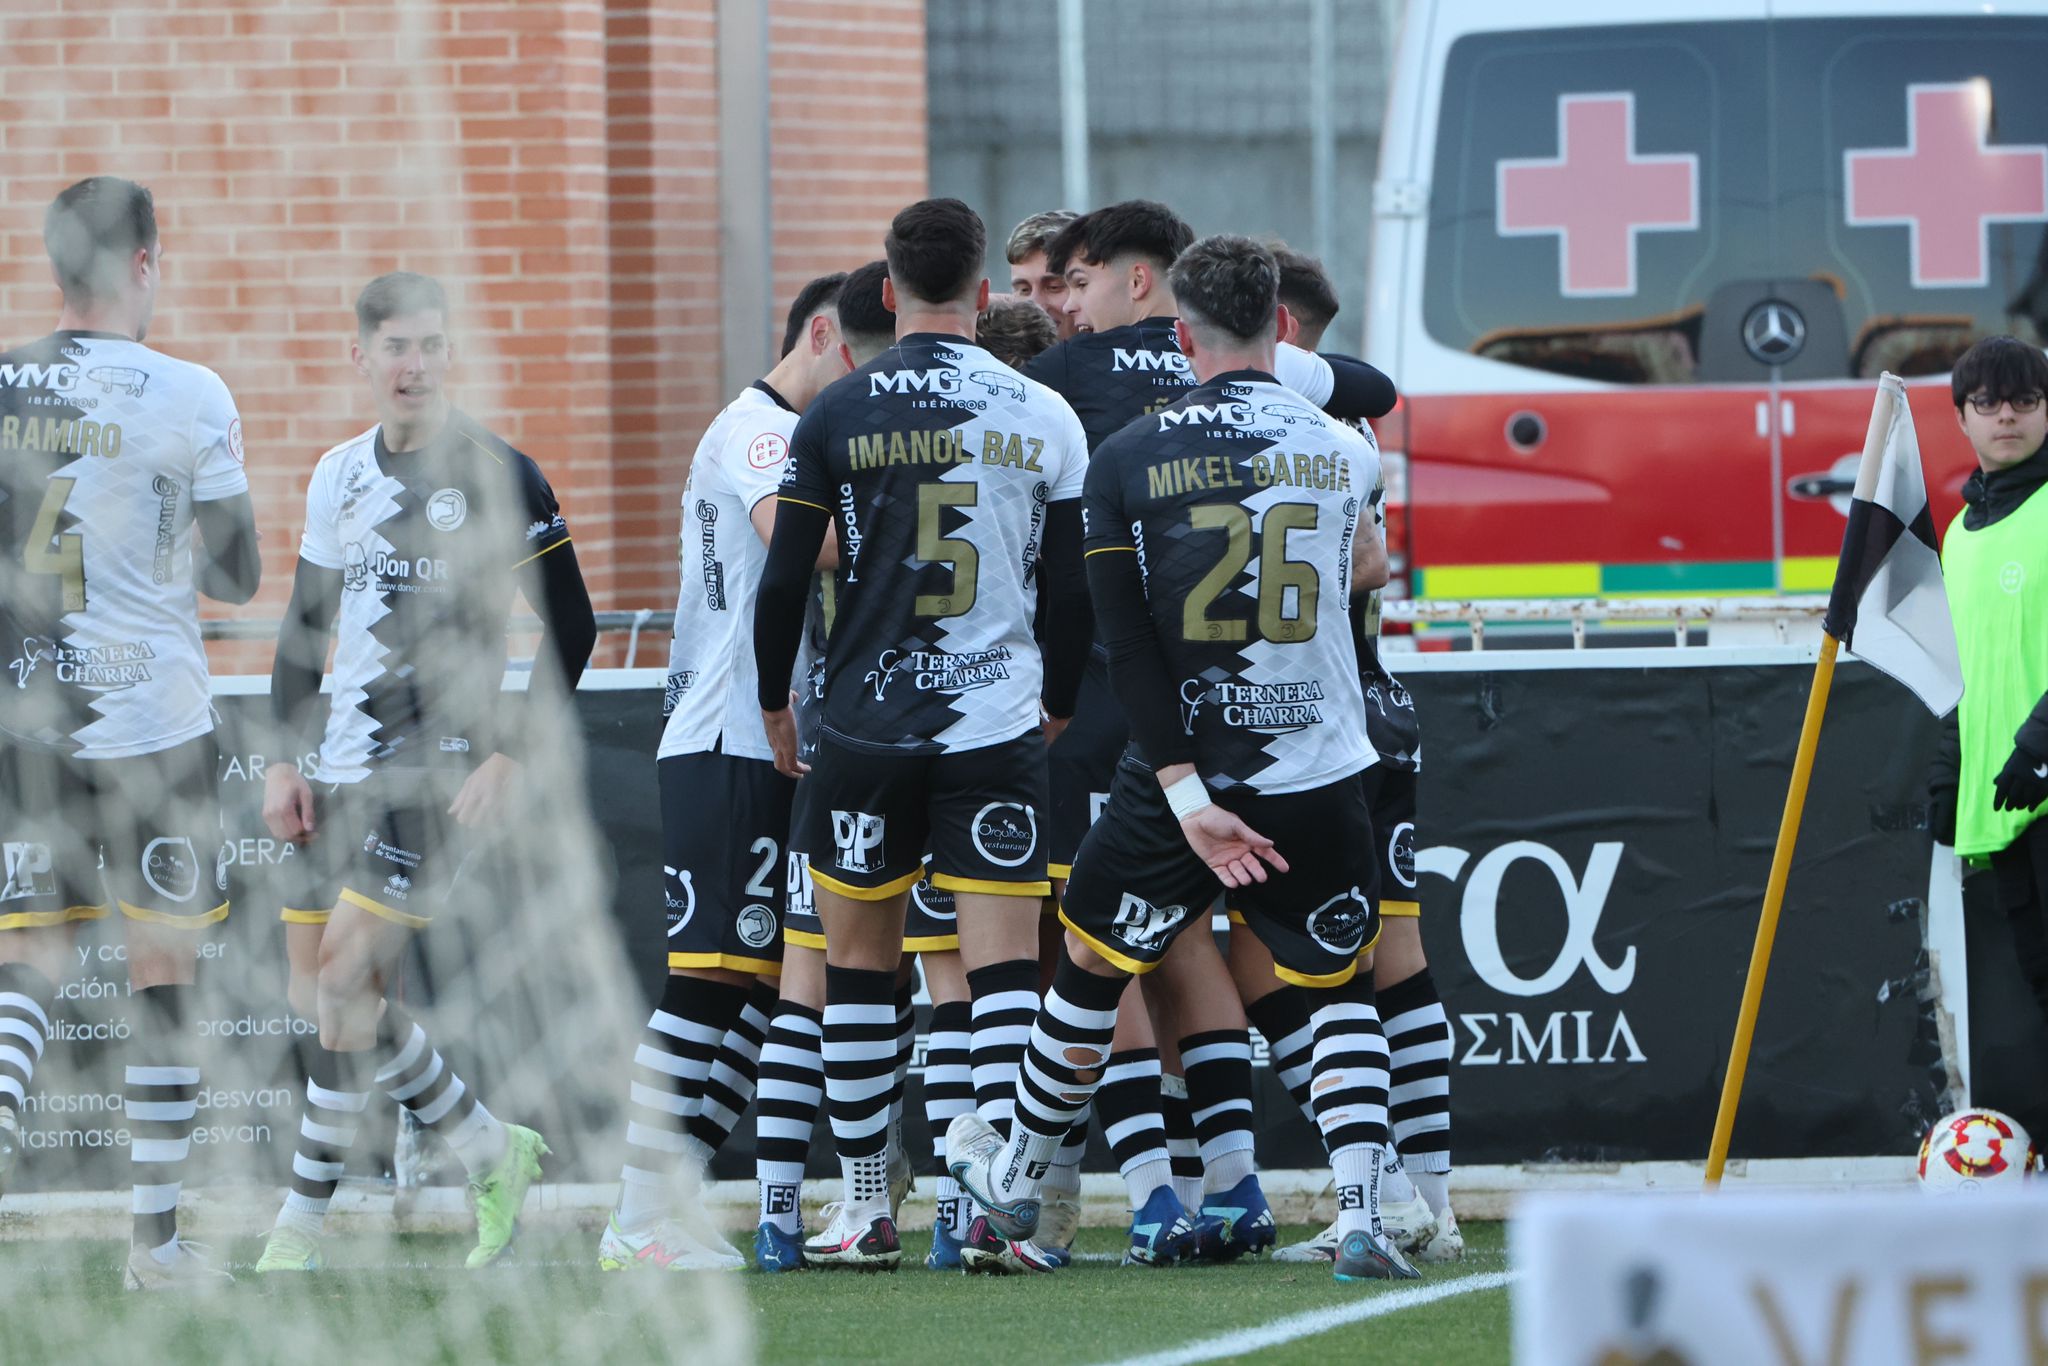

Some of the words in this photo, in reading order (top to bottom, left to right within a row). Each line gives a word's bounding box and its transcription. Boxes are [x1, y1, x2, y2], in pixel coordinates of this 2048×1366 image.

[932, 352, 964, 360] USCF
[0, 363, 81, 391] MMG
[869, 368, 962, 397] MMG
[27, 395, 98, 408] IBÉRICOS
[912, 399, 987, 410] IBÉRICOS
[1221, 386, 1254, 396] USCF
[1158, 402, 1255, 432] MMG
[2, 414, 123, 458] RAMIRO
[1205, 428, 1288, 439] IBÉRICOS
[848, 429, 973, 471] IMANOL
[981, 430, 1046, 473] BAZ
[1147, 455, 1243, 499] MIKEL
[24, 477, 86, 612] 4
[696, 499, 720, 611] GUINALDO
[914, 481, 979, 617] 5
[376, 551, 410, 578] Don
[1183, 502, 1320, 644] 26
[910, 646, 1012, 672] TERNERA
[915, 663, 1010, 690] CHARRA
[1215, 681, 1324, 704] TERNERA
[1223, 704, 1323, 725] CHARRA
[744, 837, 779, 898] 2
[769, 1187, 795, 1212] FS
